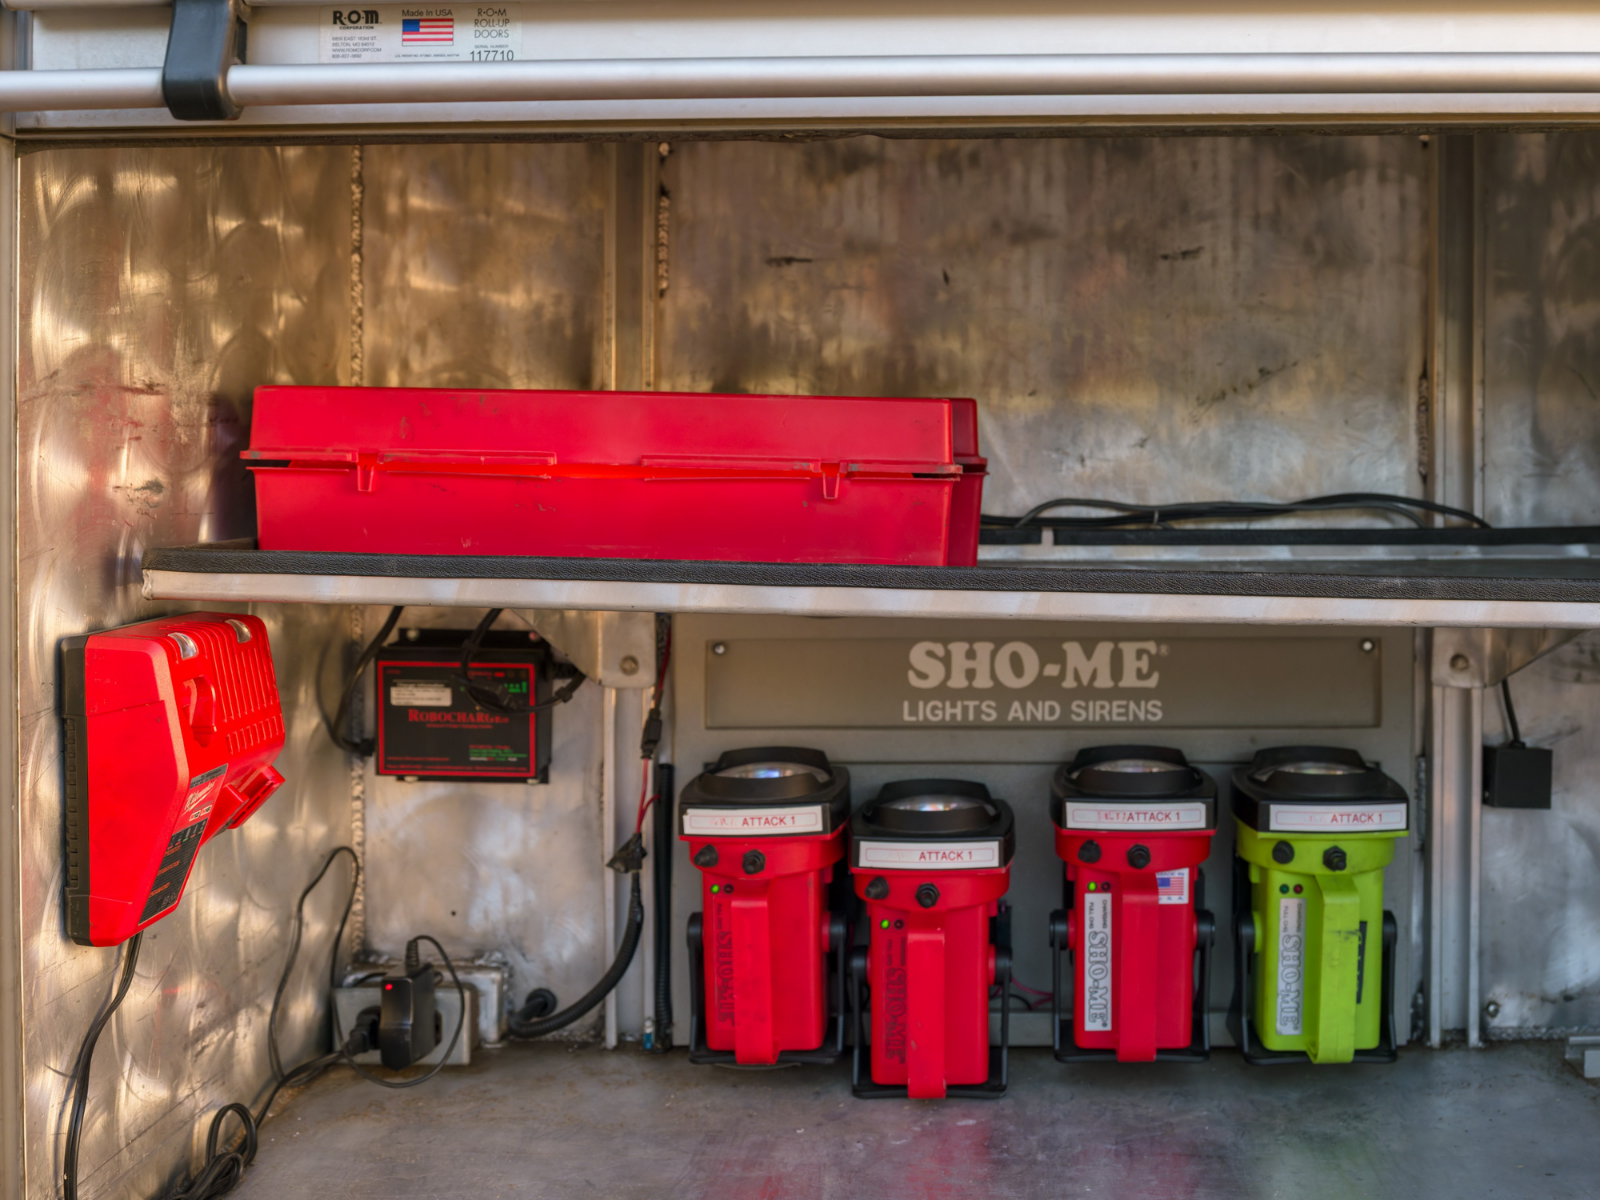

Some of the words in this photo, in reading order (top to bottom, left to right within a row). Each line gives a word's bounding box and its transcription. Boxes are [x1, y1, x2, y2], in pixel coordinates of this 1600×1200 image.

[402, 9, 425, 17] Made
[426, 9, 434, 17] In
[435, 9, 453, 17] USA
[474, 18, 510, 28] ROLL-UP
[474, 29, 510, 39] DOORS
[469, 50, 514, 62] 117710
[902, 700, 998, 722] LIGHTS
[1007, 700, 1061, 722] AND
[1070, 700, 1164, 722] SIRENS
[741, 816, 787, 827] ATTACK
[790, 815, 796, 825] 1
[1126, 811, 1172, 822] ATTACK
[1175, 811, 1181, 821] 1
[1330, 813, 1375, 824] ATTACK
[1378, 813, 1383, 822] 1
[918, 851, 964, 861] ATTACK
[968, 851, 973, 860] 1
[1088, 930, 1109, 1024] SHO-ME
[1279, 934, 1302, 1027] SHO-ME
